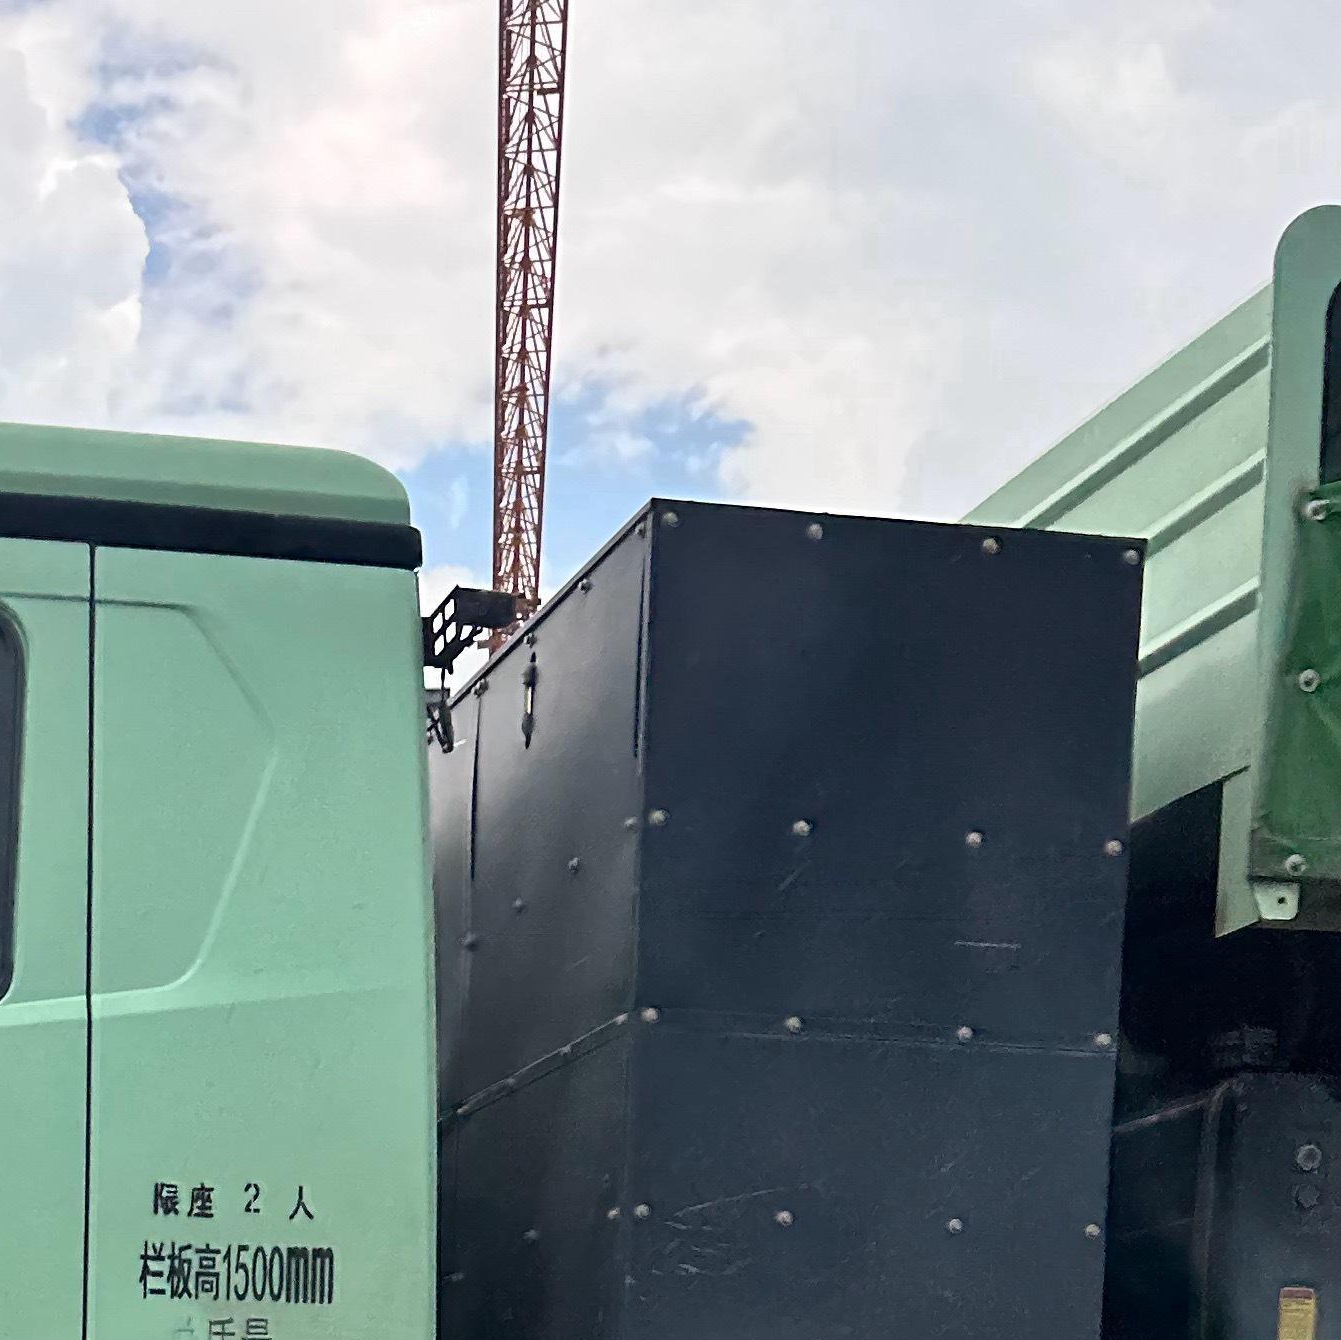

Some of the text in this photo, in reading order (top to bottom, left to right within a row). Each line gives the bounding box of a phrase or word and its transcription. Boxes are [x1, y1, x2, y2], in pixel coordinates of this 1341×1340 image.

[243, 1183, 261, 1214] 2
[289, 1185, 315, 1221] 人
[139, 1240, 334, 1305] 栏板高1500mm
